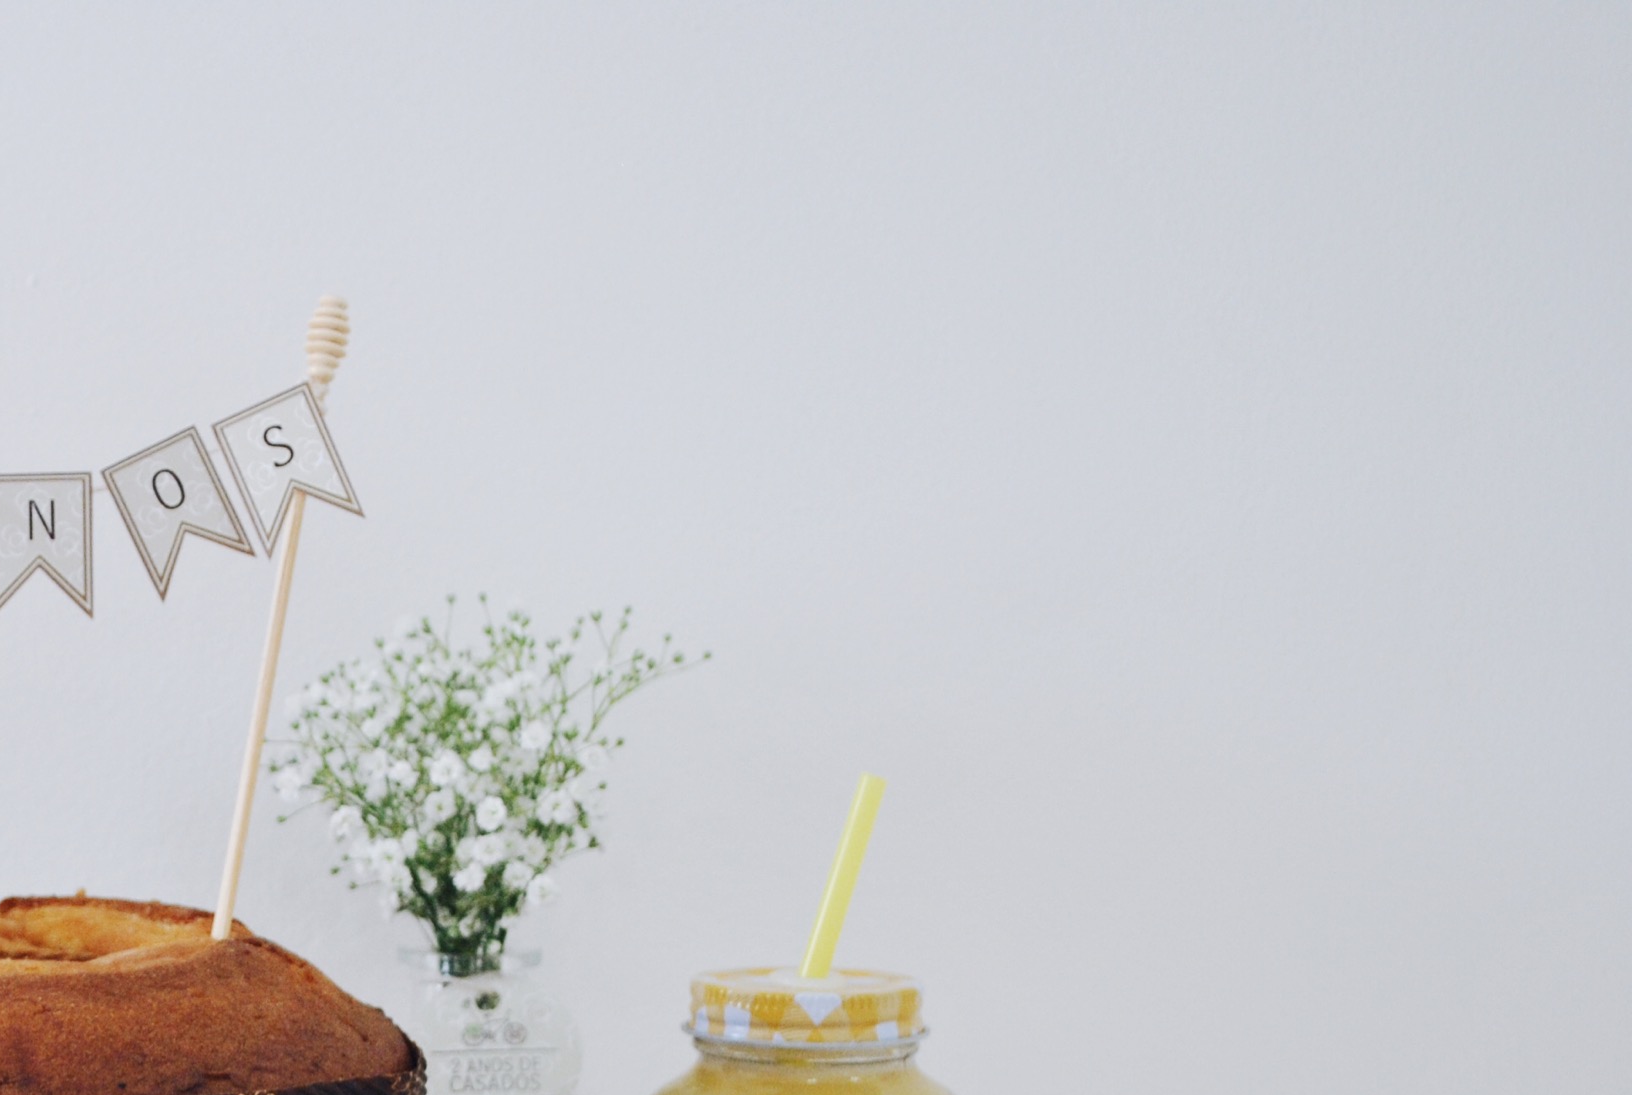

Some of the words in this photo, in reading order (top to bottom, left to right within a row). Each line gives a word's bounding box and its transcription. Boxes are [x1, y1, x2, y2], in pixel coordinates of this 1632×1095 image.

[468, 1056, 513, 1073] ANOS
[519, 1055, 541, 1071] DE
[450, 1072, 541, 1092] CASADOS
